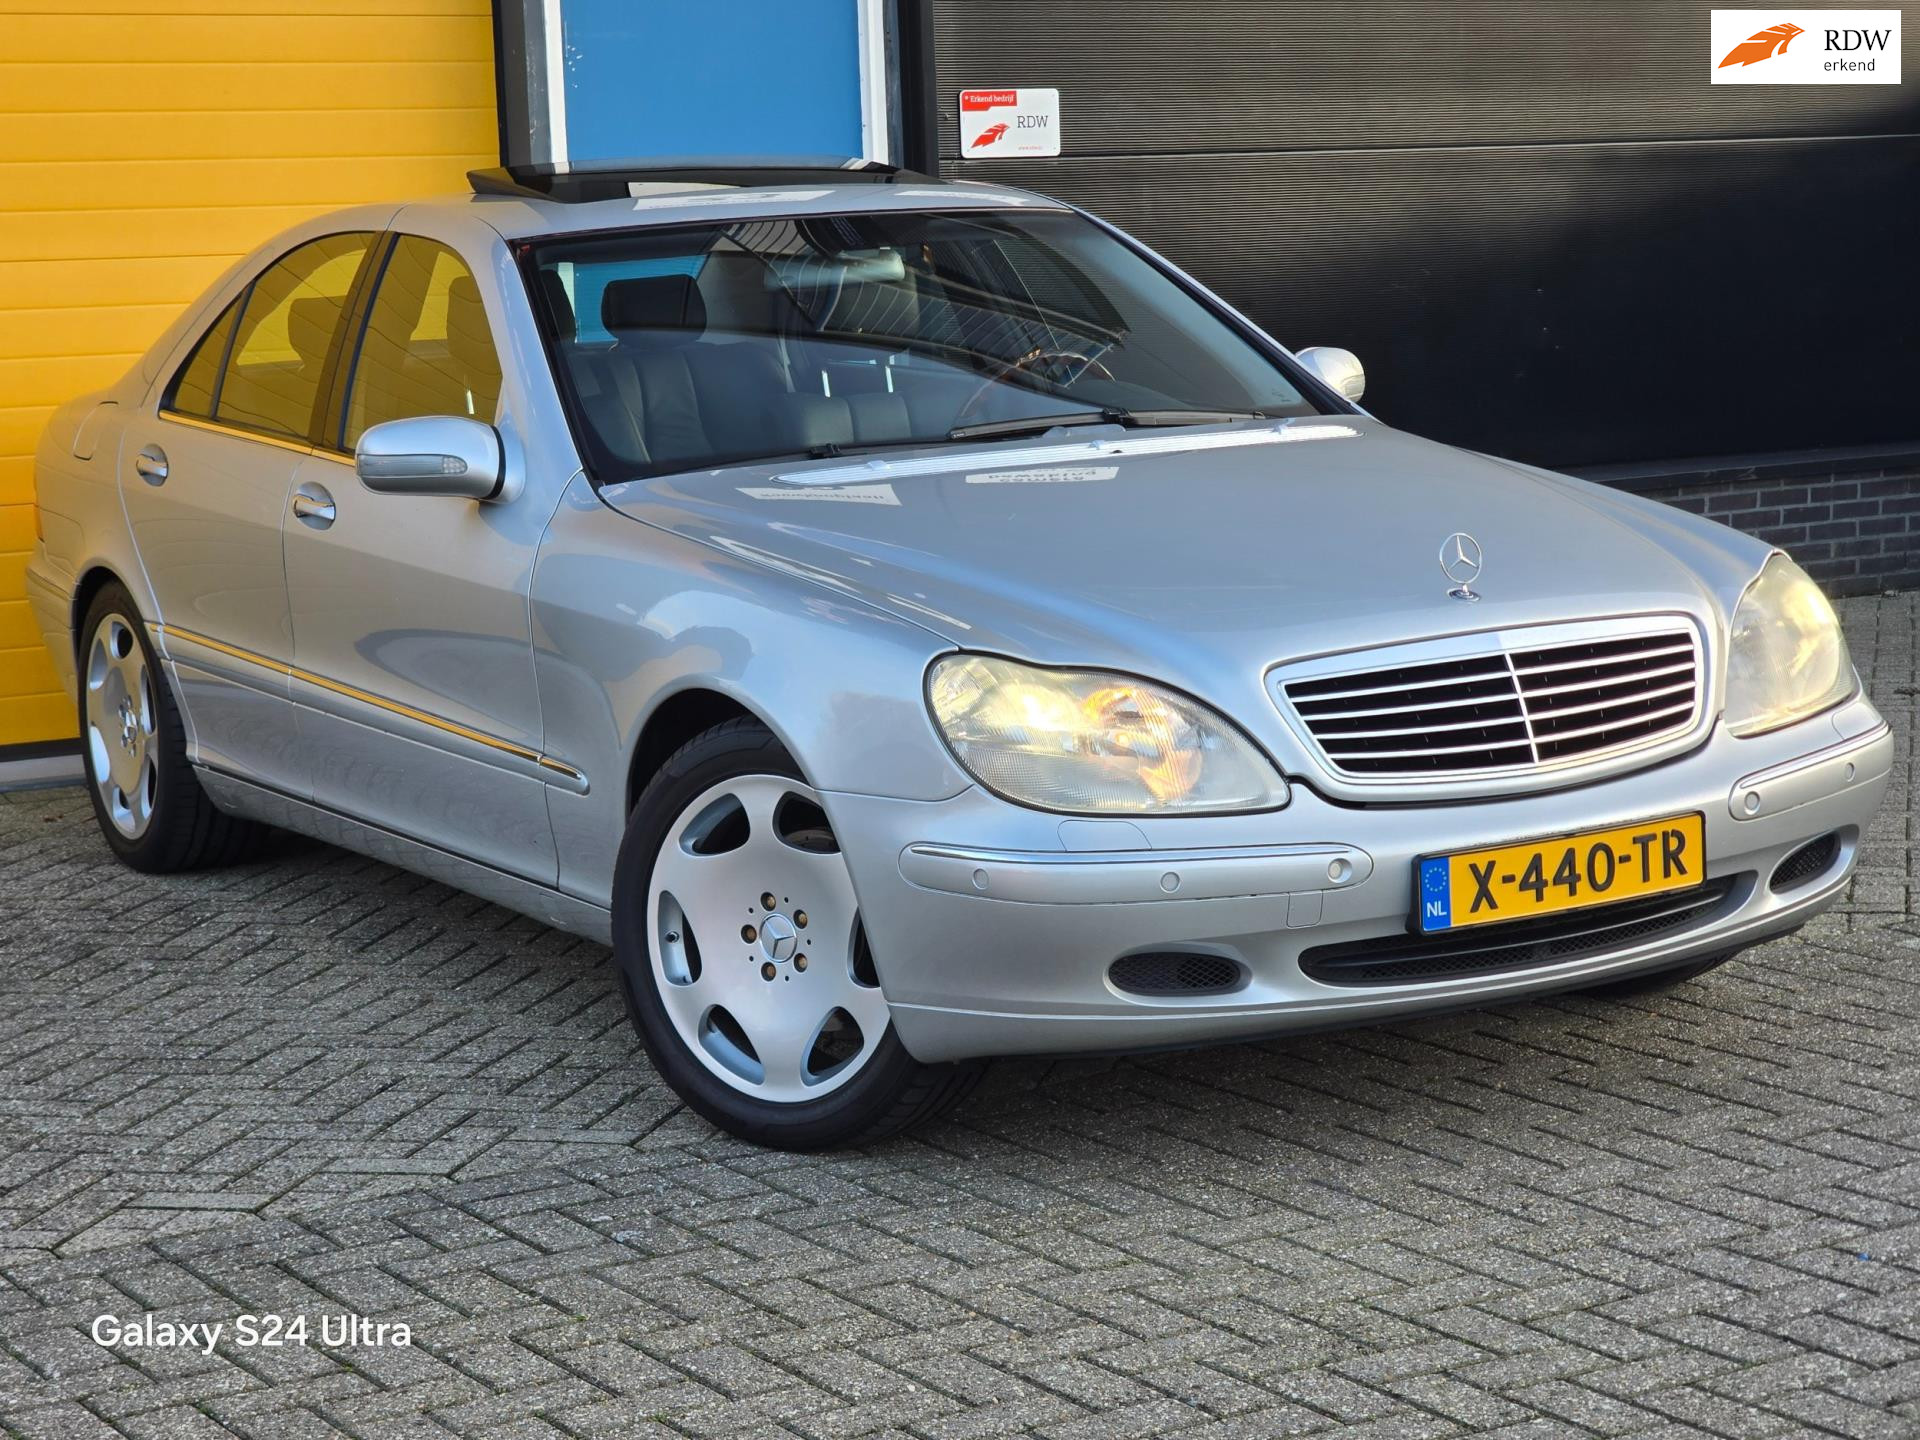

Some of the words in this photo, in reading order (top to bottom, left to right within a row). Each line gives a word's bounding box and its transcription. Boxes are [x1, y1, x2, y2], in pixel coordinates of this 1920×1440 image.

[1017, 115, 1049, 129] RDW
[1468, 828, 1688, 914] X-440-TR
[1426, 900, 1447, 918] NL
